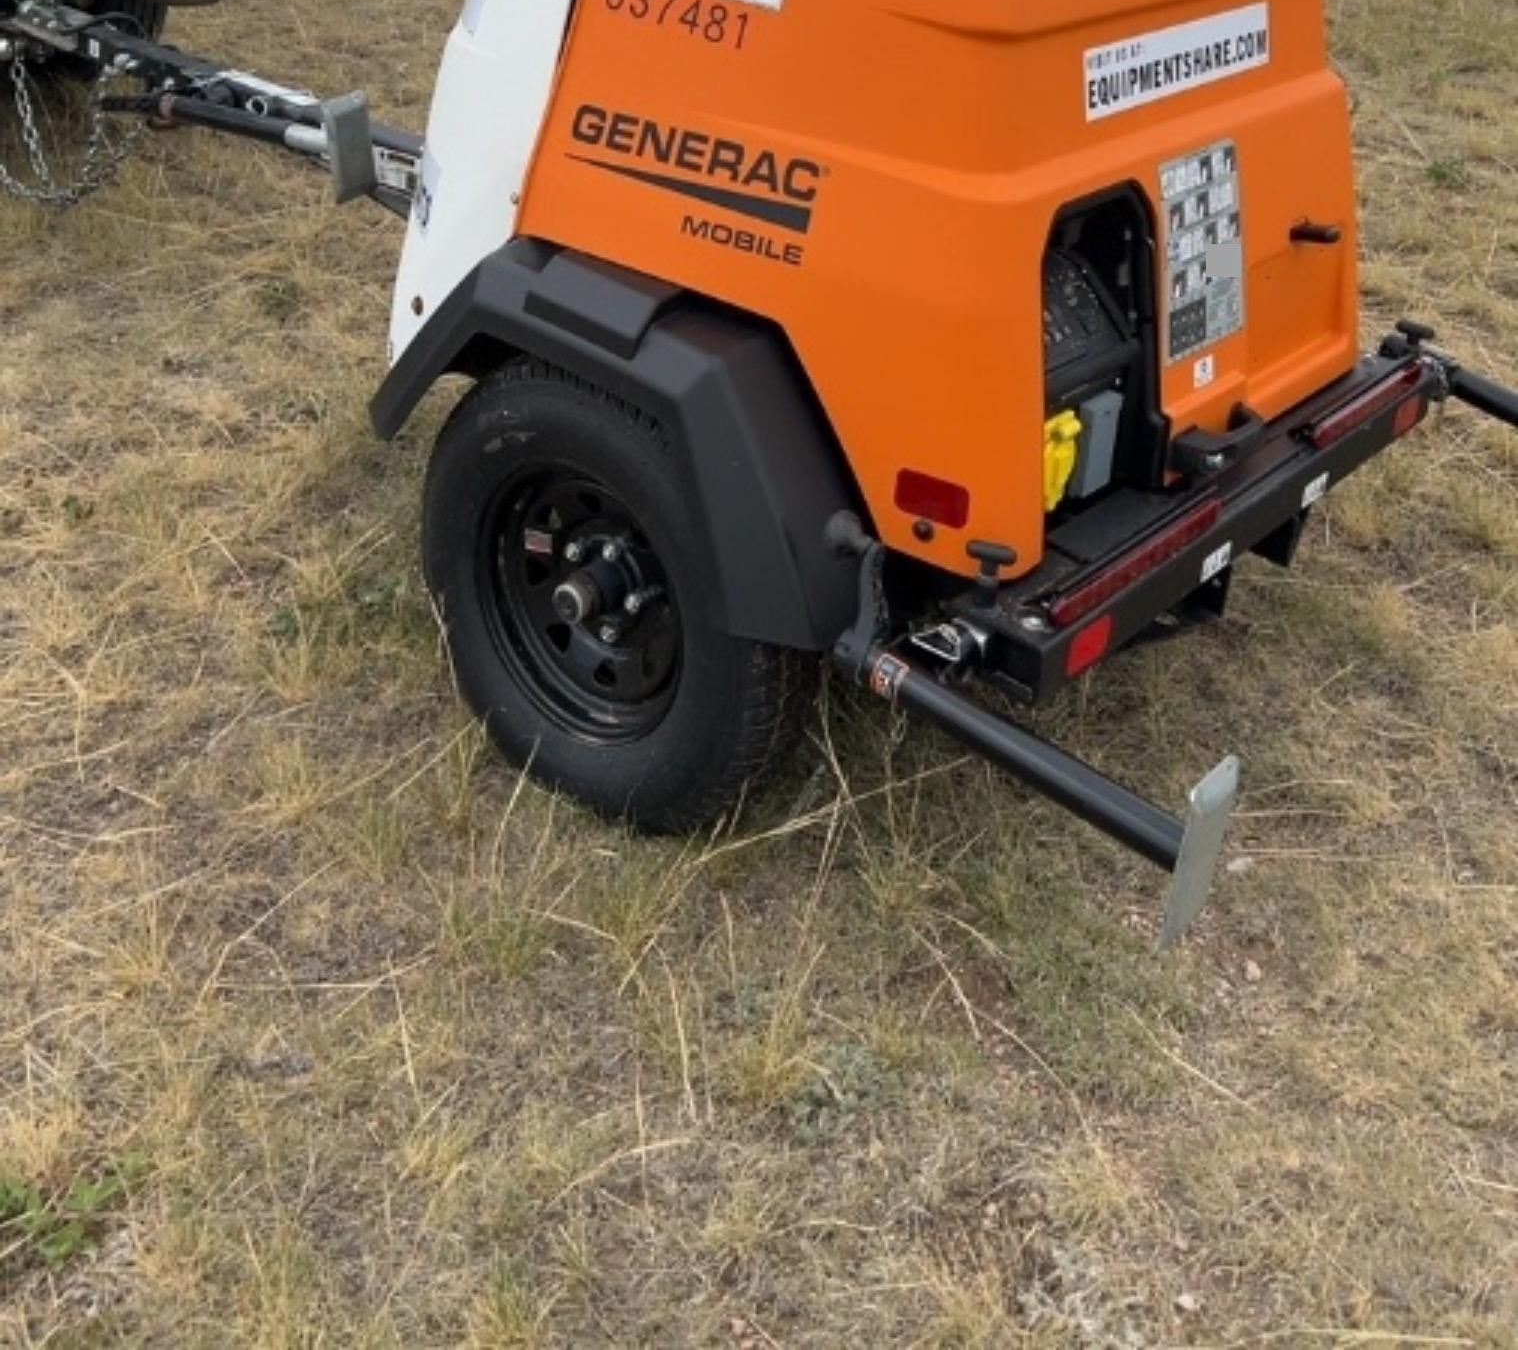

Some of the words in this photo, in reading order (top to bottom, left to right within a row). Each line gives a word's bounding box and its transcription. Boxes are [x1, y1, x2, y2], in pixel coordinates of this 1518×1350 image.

[1088, 29, 1267, 109] EQUIPMENTSHARE.COM
[572, 104, 820, 202] GENERAC
[680, 215, 804, 265] MOBILE
